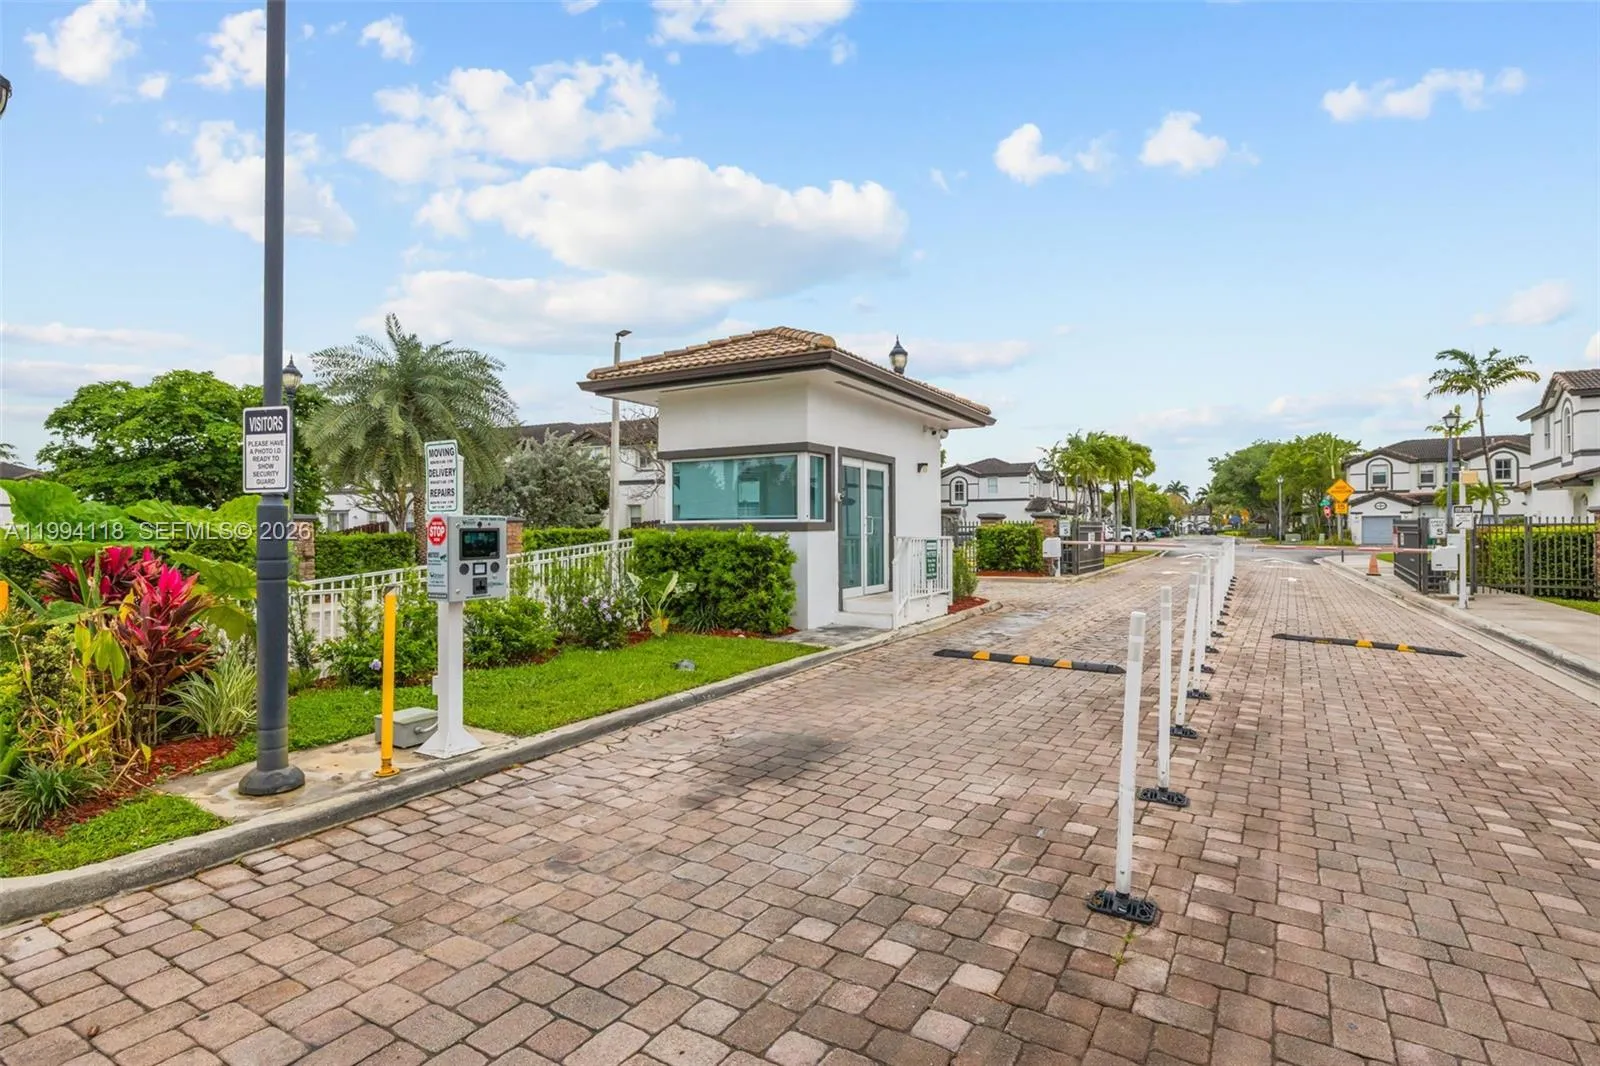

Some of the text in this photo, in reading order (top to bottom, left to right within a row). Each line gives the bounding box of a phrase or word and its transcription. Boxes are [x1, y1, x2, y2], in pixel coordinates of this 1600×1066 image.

[249, 416, 283, 432] VISITORS
[429, 447, 454, 457] MOVING
[429, 468, 455, 477] DELIVERY
[430, 488, 455, 497] REPAIRS
[429, 526, 445, 537] STOP
